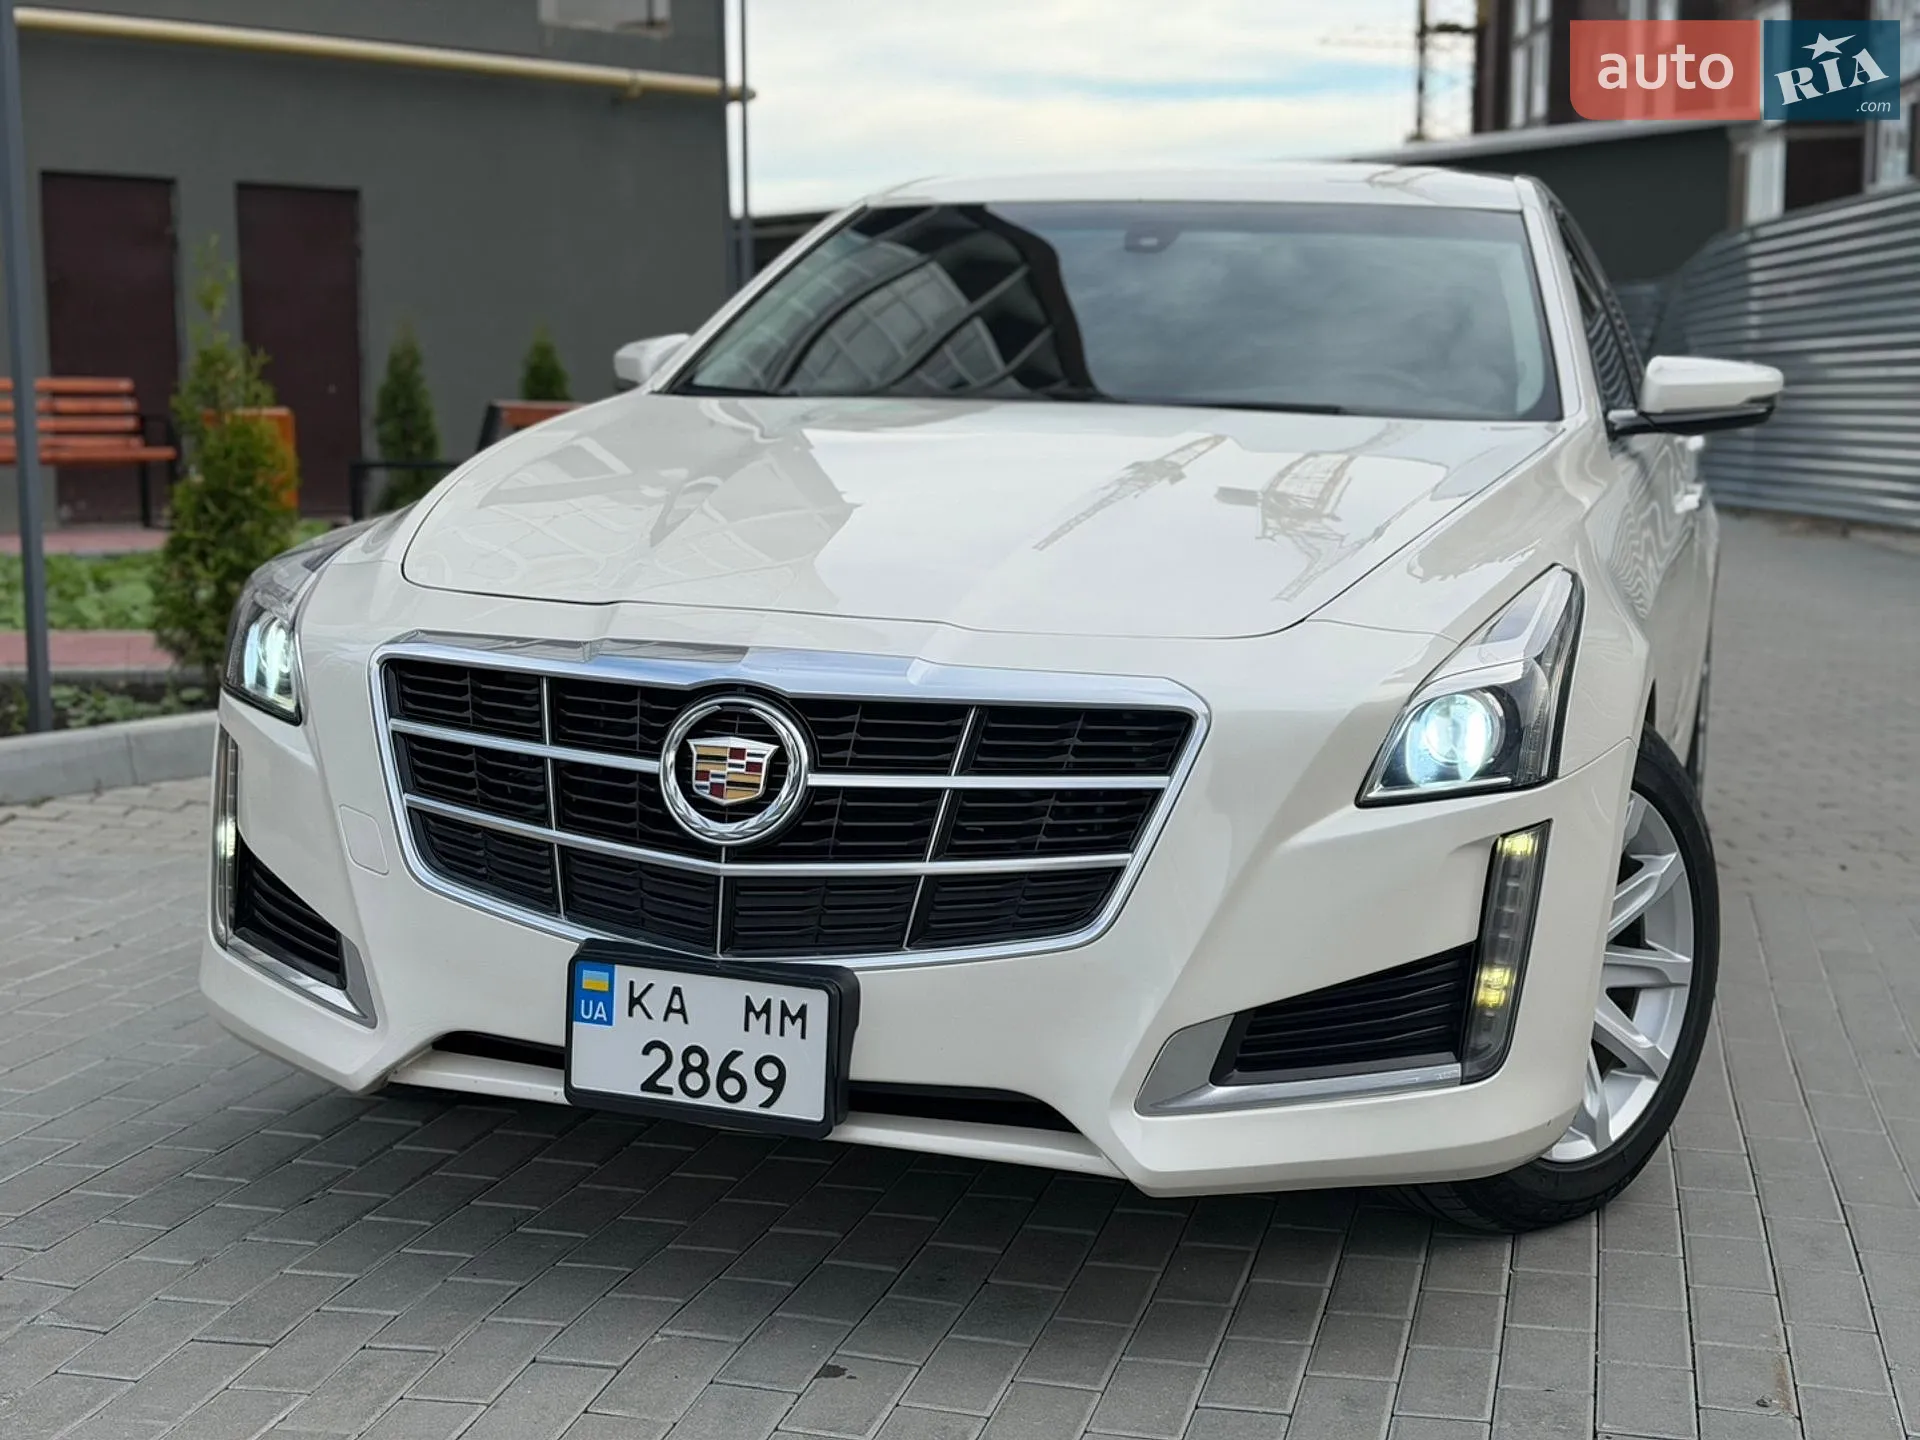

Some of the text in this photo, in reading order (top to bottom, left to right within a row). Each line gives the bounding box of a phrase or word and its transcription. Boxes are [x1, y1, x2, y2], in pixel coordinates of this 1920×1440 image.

[580, 999, 607, 1022] UA
[627, 980, 808, 1040] KA MM
[640, 1040, 787, 1109] 2869
